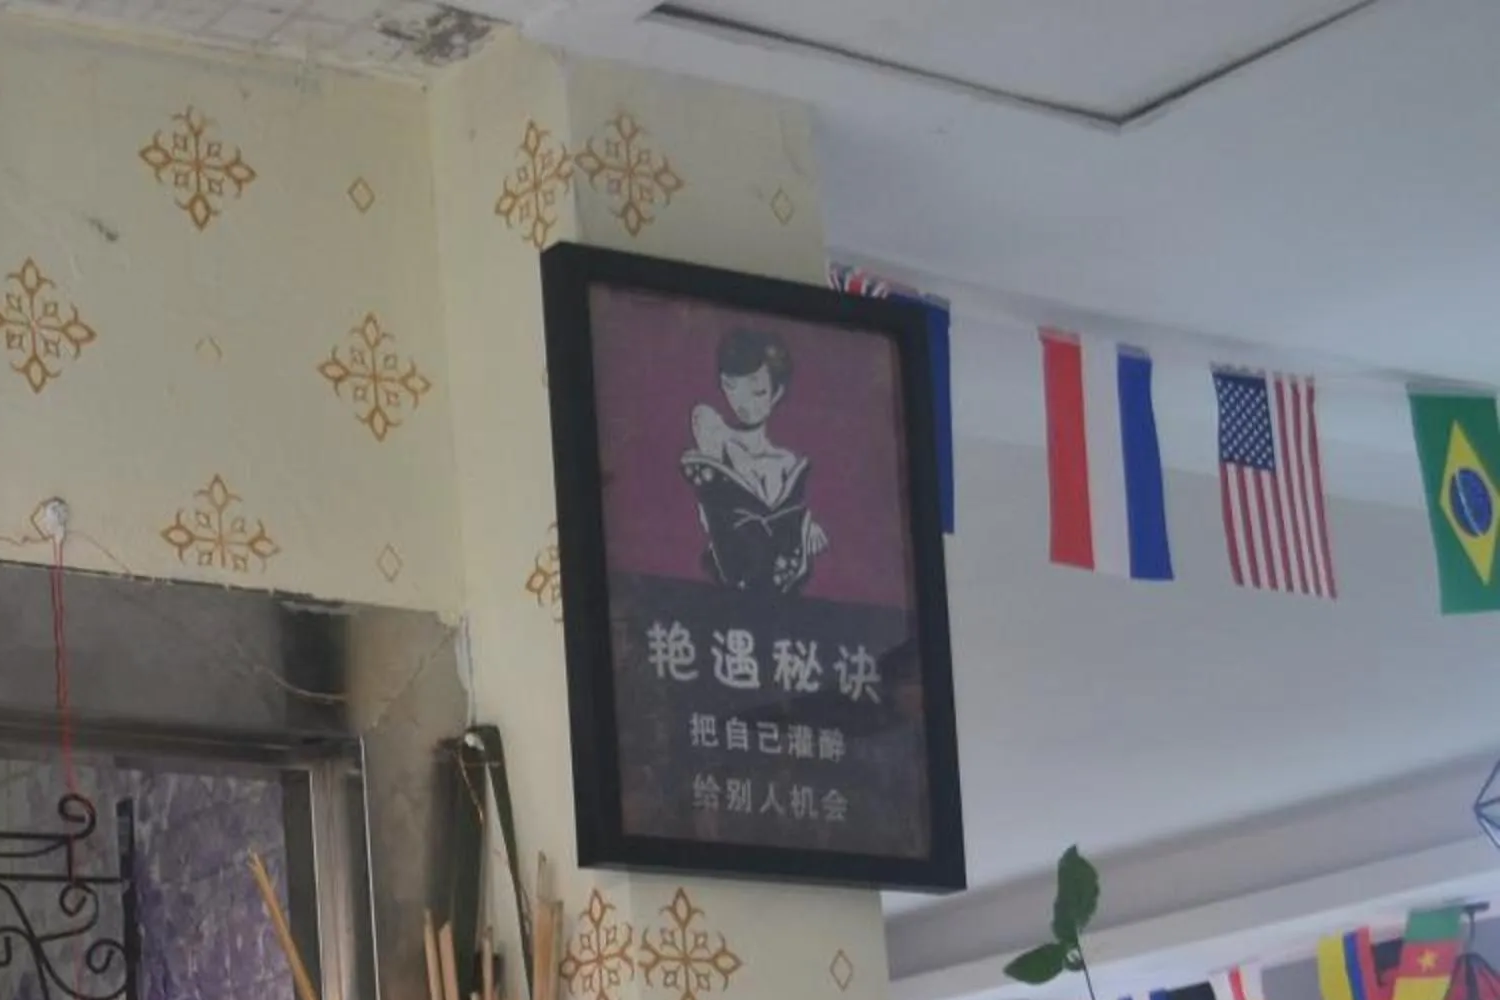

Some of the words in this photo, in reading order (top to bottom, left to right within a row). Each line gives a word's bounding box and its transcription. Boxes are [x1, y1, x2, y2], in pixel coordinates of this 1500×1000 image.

[646, 620, 881, 703] 艳遇秘诀
[689, 712, 846, 763] 把自己灌醉
[692, 773, 849, 823] 给别人机会
